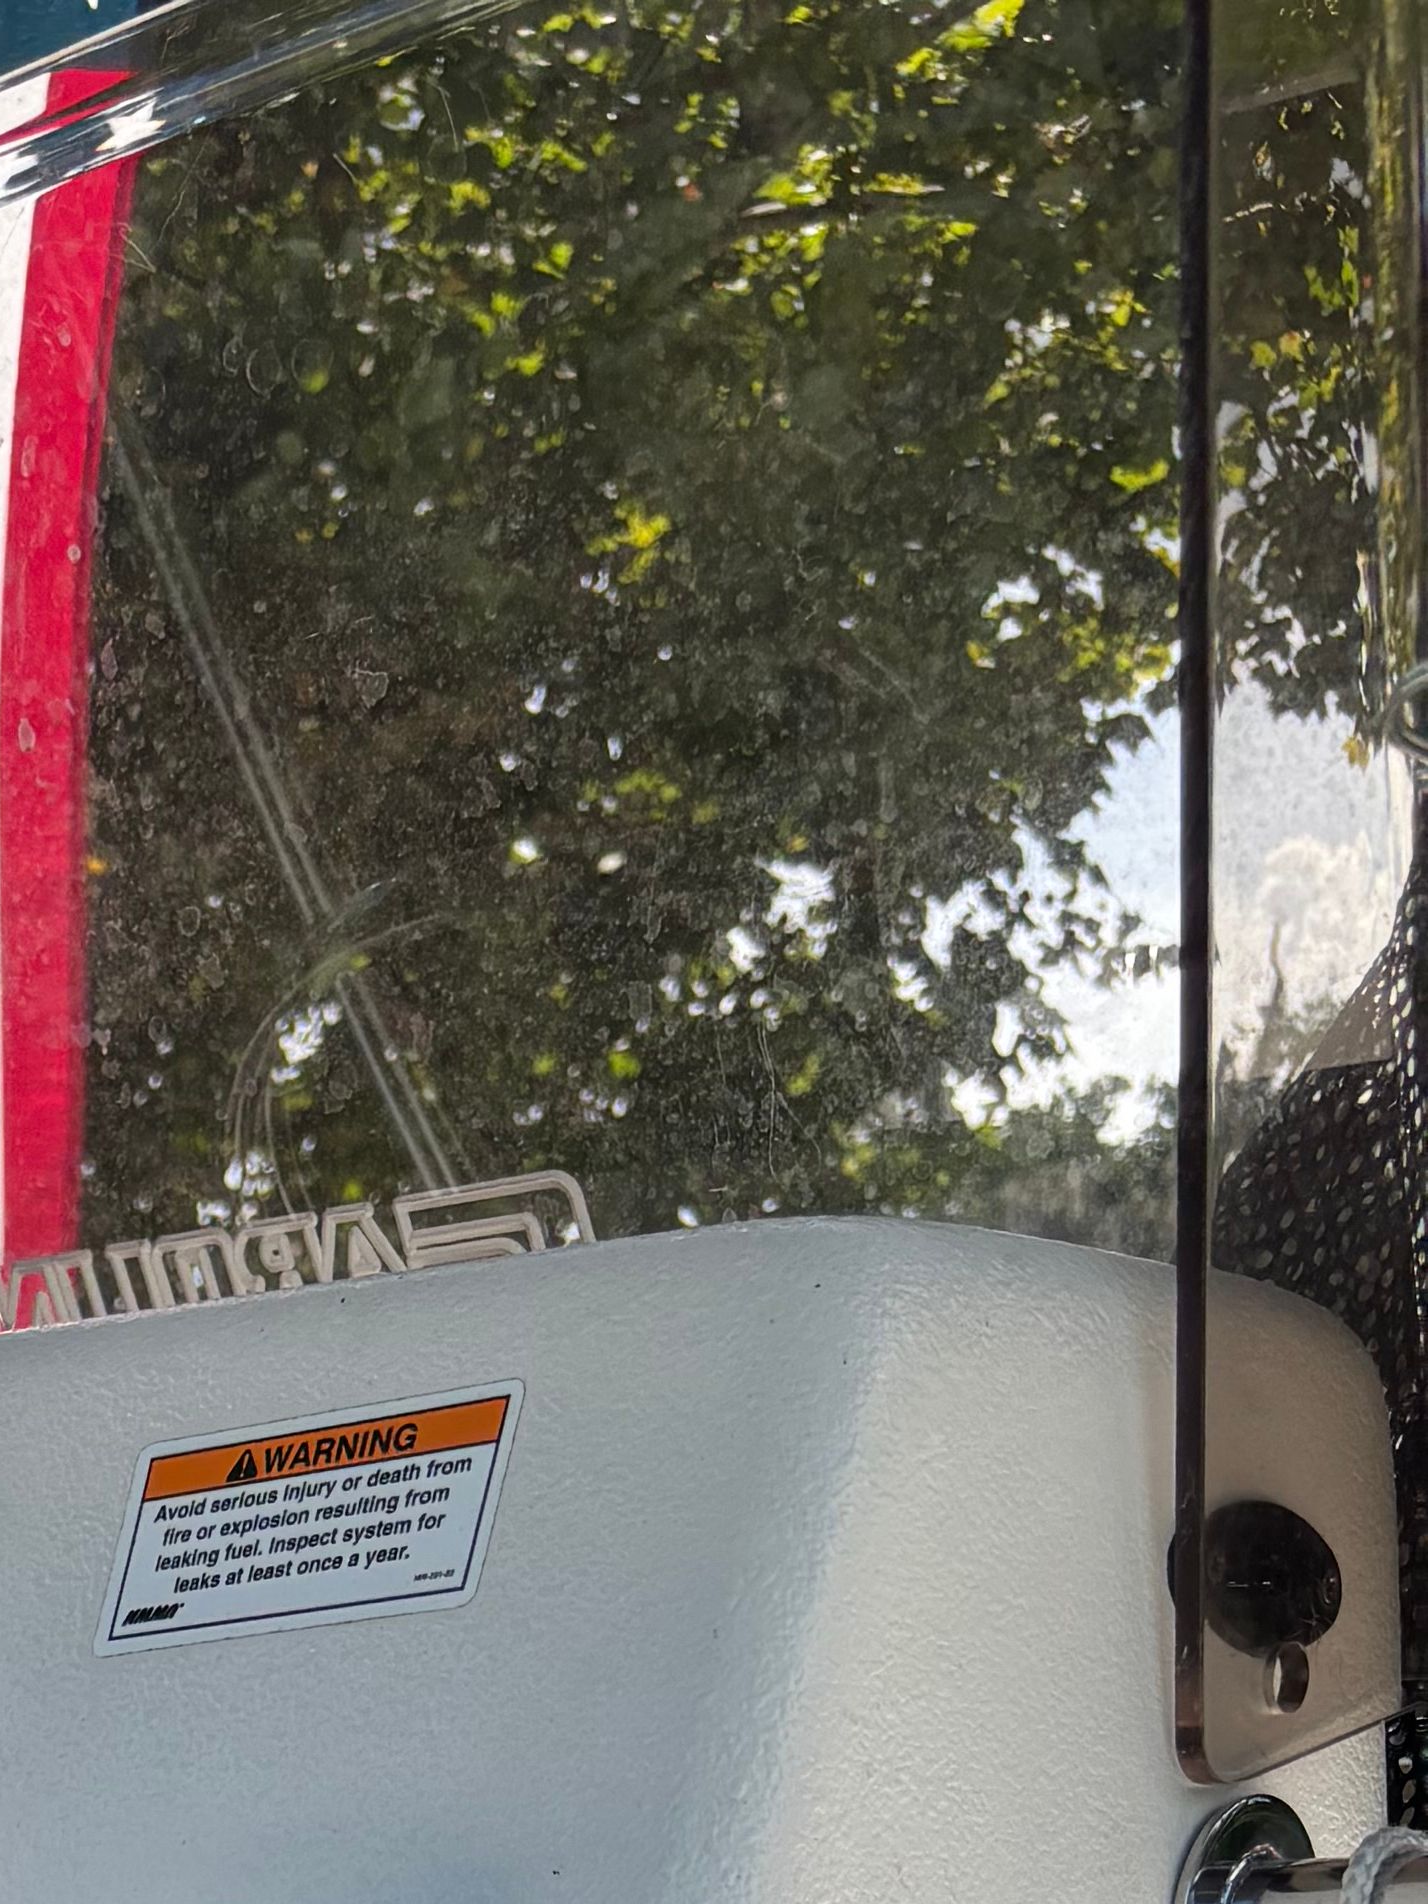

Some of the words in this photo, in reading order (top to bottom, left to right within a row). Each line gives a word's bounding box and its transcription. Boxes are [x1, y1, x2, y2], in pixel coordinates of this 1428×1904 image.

[265, 1423, 418, 1474] WARNING
[154, 1498, 206, 1523] Avoid
[210, 1489, 278, 1513] serious
[283, 1481, 337, 1503] injury
[342, 1476, 363, 1491] or
[367, 1463, 421, 1487] death
[426, 1457, 472, 1478] from
[162, 1527, 192, 1546] fire
[196, 1524, 216, 1540] or
[220, 1509, 310, 1538] explosion
[315, 1494, 400, 1522] resulting
[404, 1487, 450, 1508] from
[155, 1548, 220, 1572] leaking
[224, 1539, 263, 1561] fuel.
[268, 1527, 338, 1555] Inspect
[342, 1519, 412, 1546] system
[417, 1512, 447, 1532] for
[173, 1572, 220, 1594] leaks
[225, 1568, 244, 1585] at
[247, 1560, 293, 1582] least
[297, 1554, 343, 1575] once
[347, 1553, 359, 1567] a
[364, 1545, 410, 1570] year.
